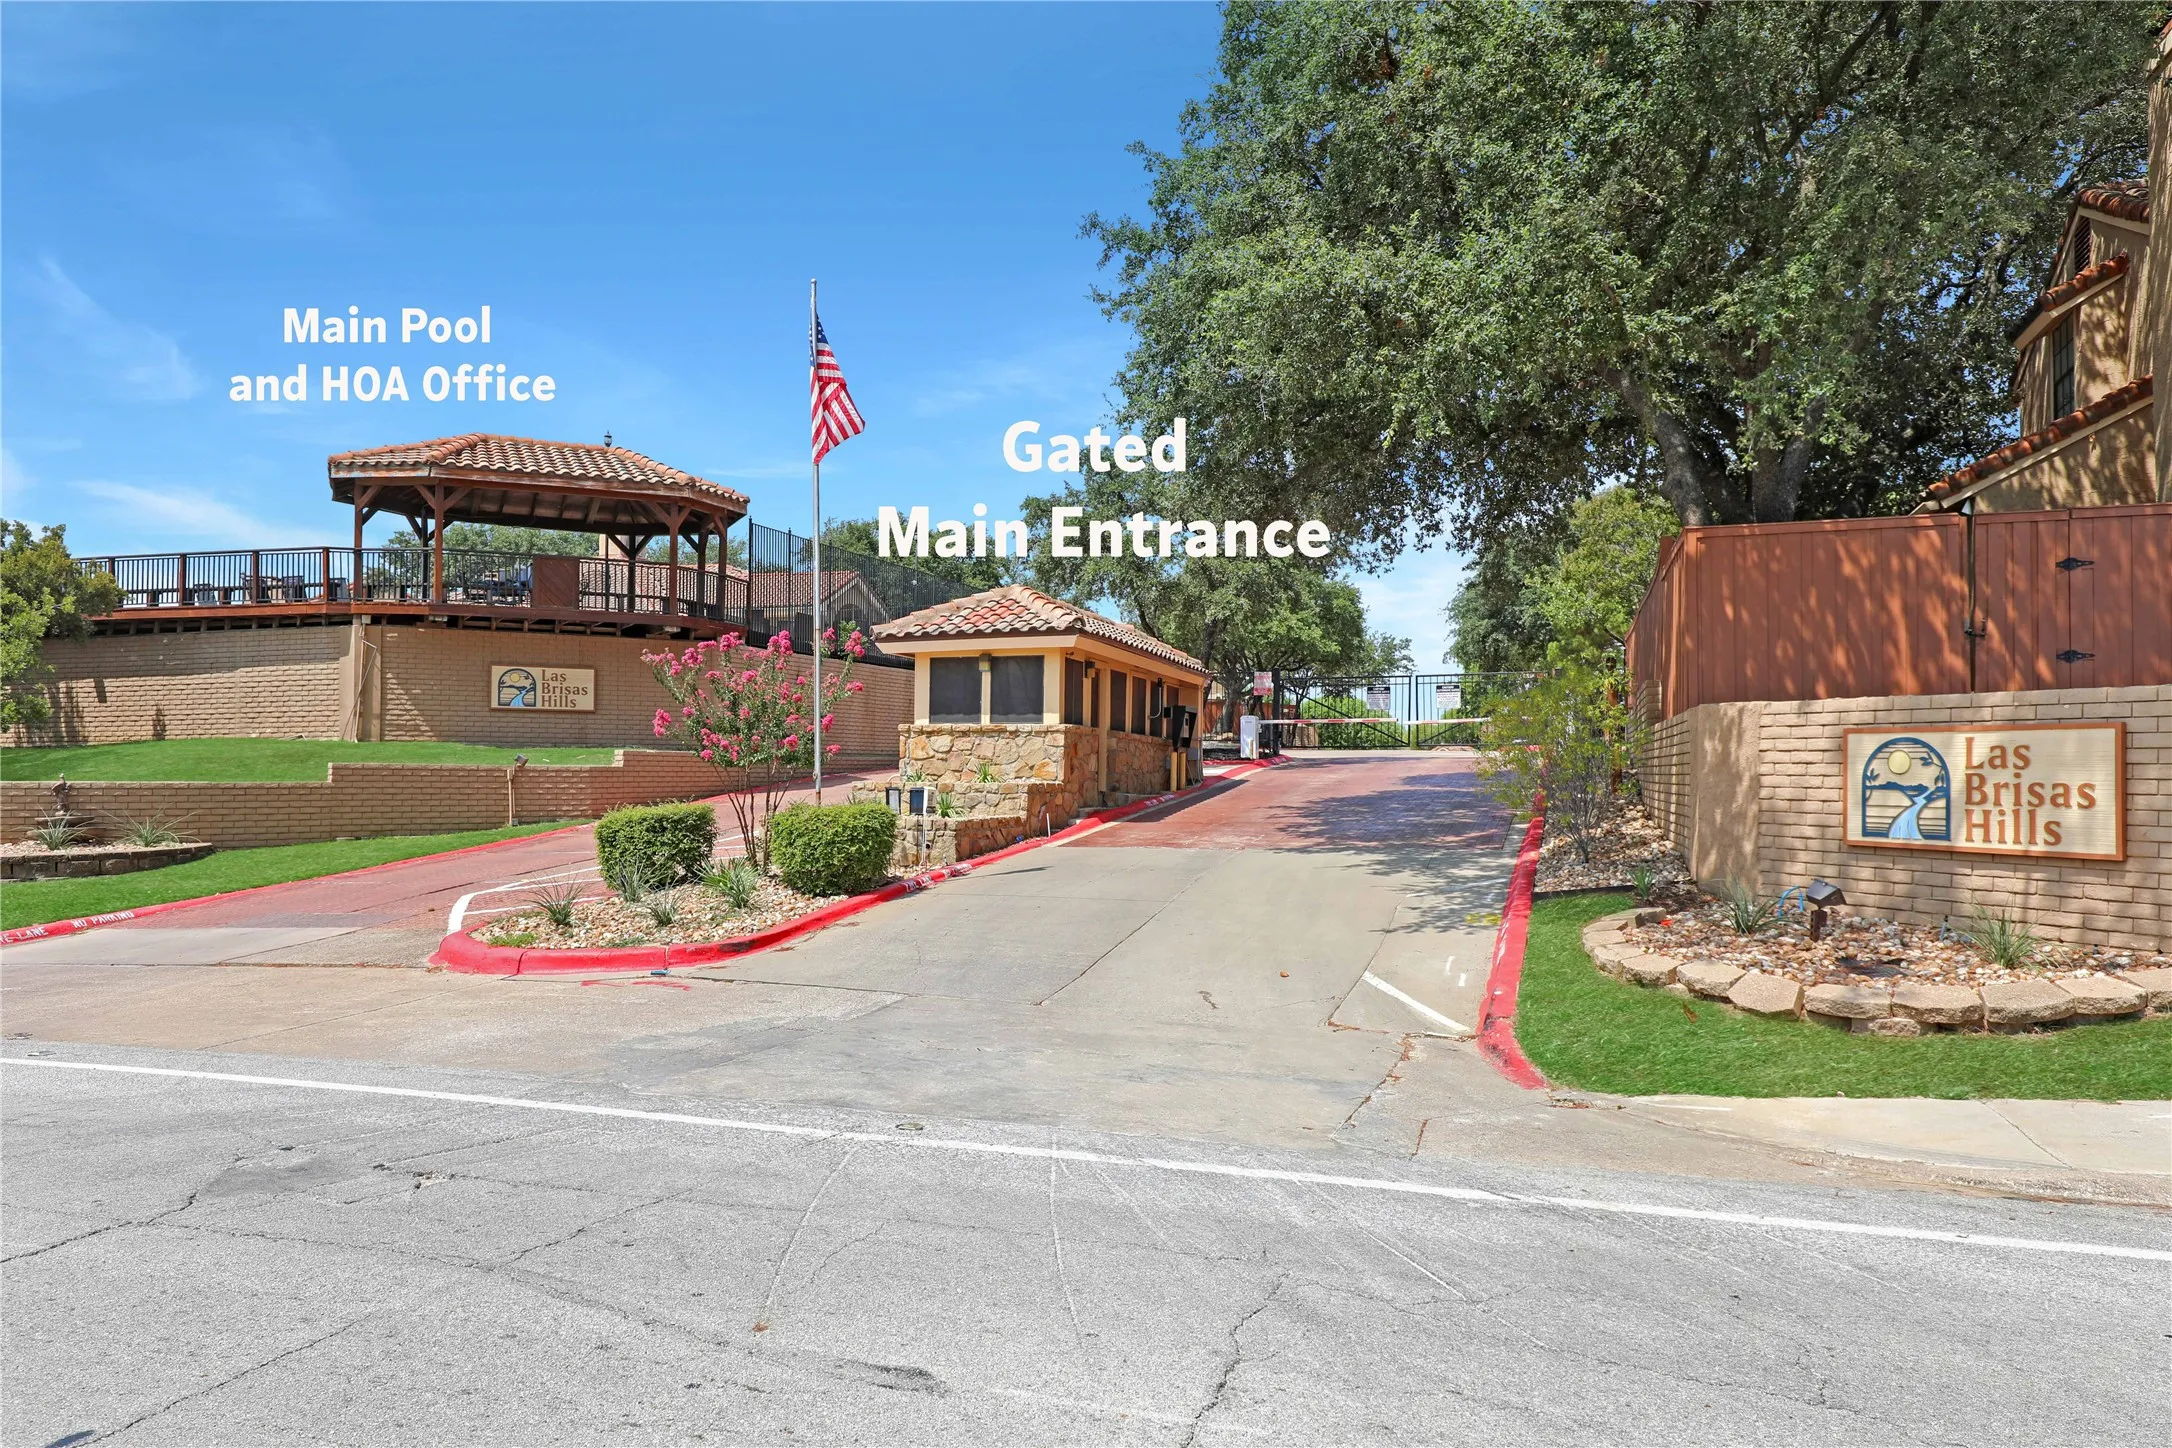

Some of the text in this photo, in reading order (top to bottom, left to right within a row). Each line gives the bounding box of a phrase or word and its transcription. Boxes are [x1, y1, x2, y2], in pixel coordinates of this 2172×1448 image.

[541, 669, 567, 683] Las
[541, 682, 588, 696] Brisas
[541, 695, 577, 709] Hills
[1964, 736, 2032, 770] Las
[1964, 772, 2097, 810] Brisas
[1964, 808, 2063, 847] Hills
